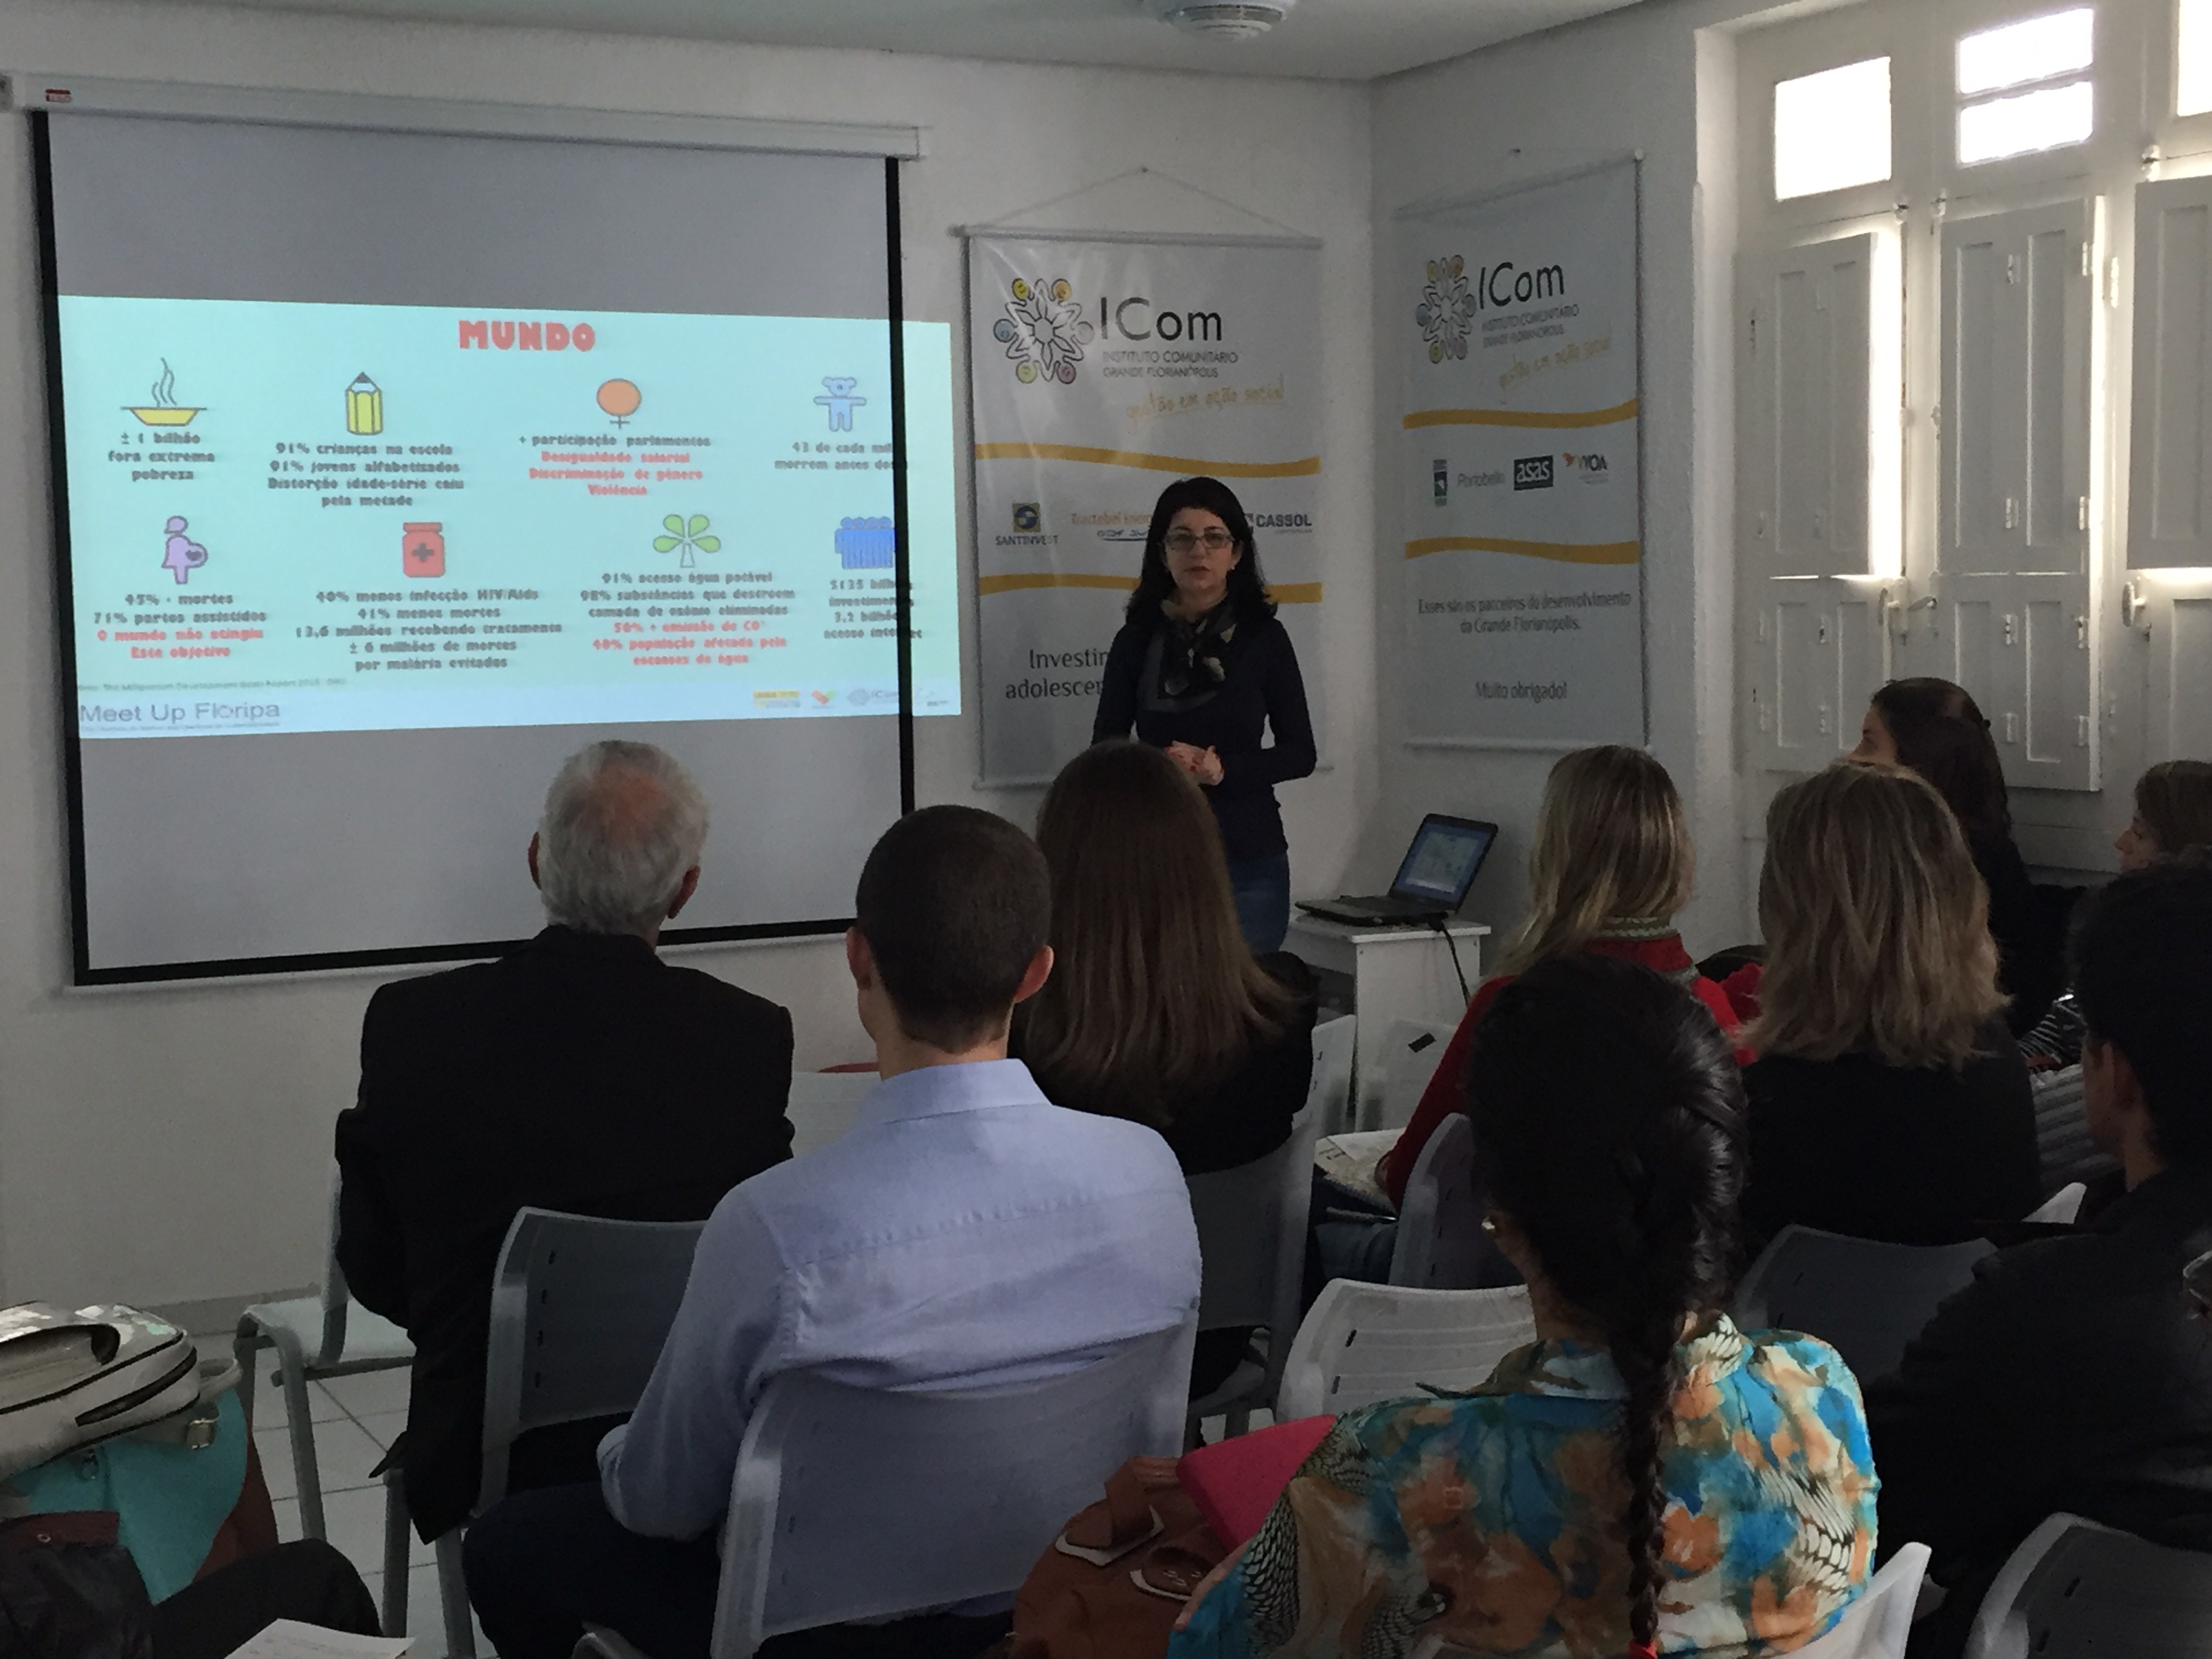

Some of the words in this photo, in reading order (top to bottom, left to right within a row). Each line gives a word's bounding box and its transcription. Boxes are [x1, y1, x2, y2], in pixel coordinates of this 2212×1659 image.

[1478, 262, 1565, 309] ICom
[1100, 296, 1221, 341] ICom
[459, 320, 595, 352] MUNDO
[1103, 350, 1160, 363] INSTITUTO
[154, 432, 201, 444] bilhão
[532, 434, 617, 447] participação
[316, 444, 377, 455] crianças
[386, 446, 403, 455] na
[409, 445, 452, 455] escola
[816, 443, 830, 453] de
[836, 443, 864, 453] cada
[108, 451, 141, 462] fora
[149, 452, 216, 462] extrema
[541, 451, 632, 464] Desigualdade
[311, 461, 356, 473] jovens
[775, 461, 828, 469] morrem
[835, 461, 868, 470] antes
[132, 469, 194, 482] pobreza
[635, 469, 649, 480] de
[322, 496, 351, 508] pela
[359, 496, 412, 506] metade
[1256, 514, 1312, 527] CASSOL
[995, 535, 1058, 546] SANTINVEST
[639, 574, 681, 583] acesso
[726, 572, 772, 584] potável
[178, 594, 234, 605] mortes
[356, 592, 403, 602] menos
[410, 590, 468, 602] infecção
[703, 591, 726, 601] que
[1541, 592, 1631, 609] desenvolvimento
[192, 611, 266, 623] assistidos
[396, 609, 443, 619] menos
[450, 608, 500, 618] mortes
[589, 607, 640, 617] camada
[647, 607, 663, 617] de
[401, 623, 475, 634] recebendo
[483, 624, 562, 634] tratamento
[722, 621, 737, 632] de
[1475, 617, 1511, 633] Grande
[98, 630, 107, 641] O
[115, 630, 166, 641] mundo
[176, 628, 203, 640] não
[823, 630, 864, 639] acesso
[443, 640, 459, 651] de
[466, 640, 517, 651] mortes
[629, 636, 695, 651] população
[169, 647, 230, 659] objetivo
[1029, 648, 1109, 668] Investin
[356, 660, 381, 672] por
[387, 657, 442, 670] malária
[449, 657, 508, 668] evitadas
[695, 655, 711, 664] de
[1005, 678, 1103, 699] adolescen
[1475, 680, 1508, 699] Muito
[80, 705, 142, 722] Meet
[151, 703, 186, 724] Up
[194, 702, 281, 720] Floripa
